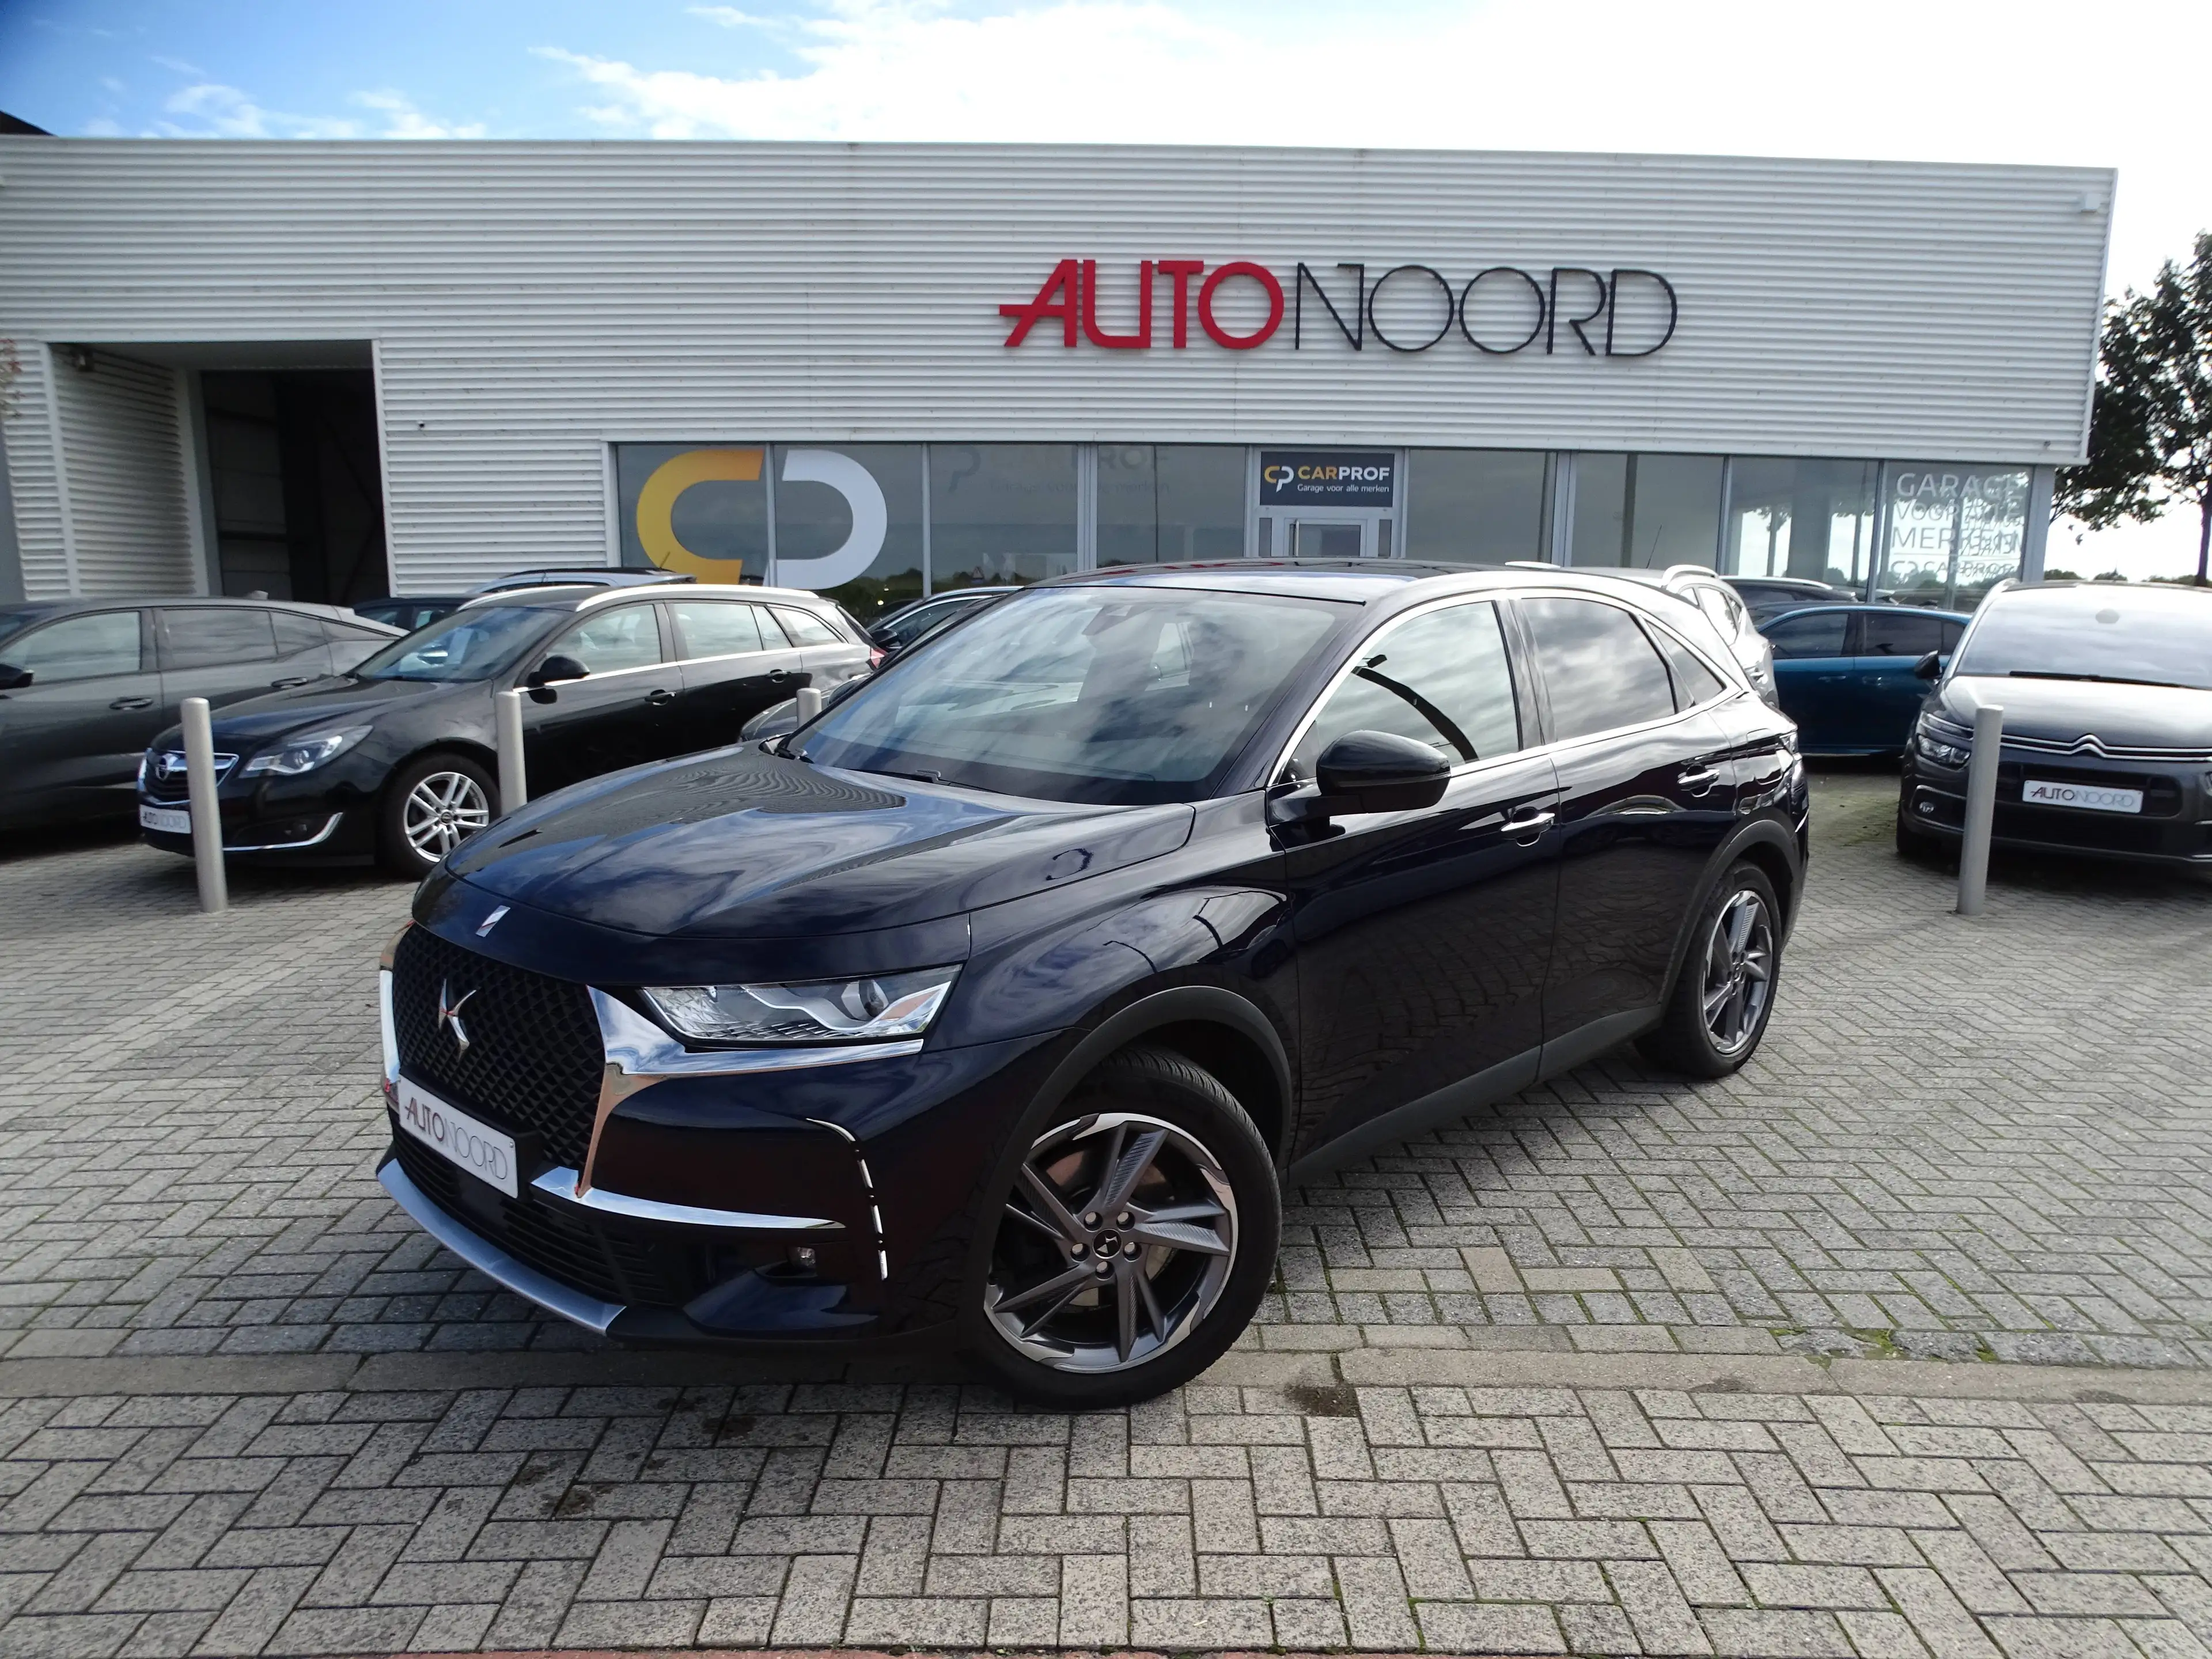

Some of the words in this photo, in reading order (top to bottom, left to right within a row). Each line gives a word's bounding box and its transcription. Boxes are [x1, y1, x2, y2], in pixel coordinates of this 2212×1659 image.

[1298, 466, 1390, 480] CARPROF
[1297, 484, 1324, 493] Garage
[1346, 484, 1359, 493] alle
[1896, 472, 2023, 501] GARAGE
